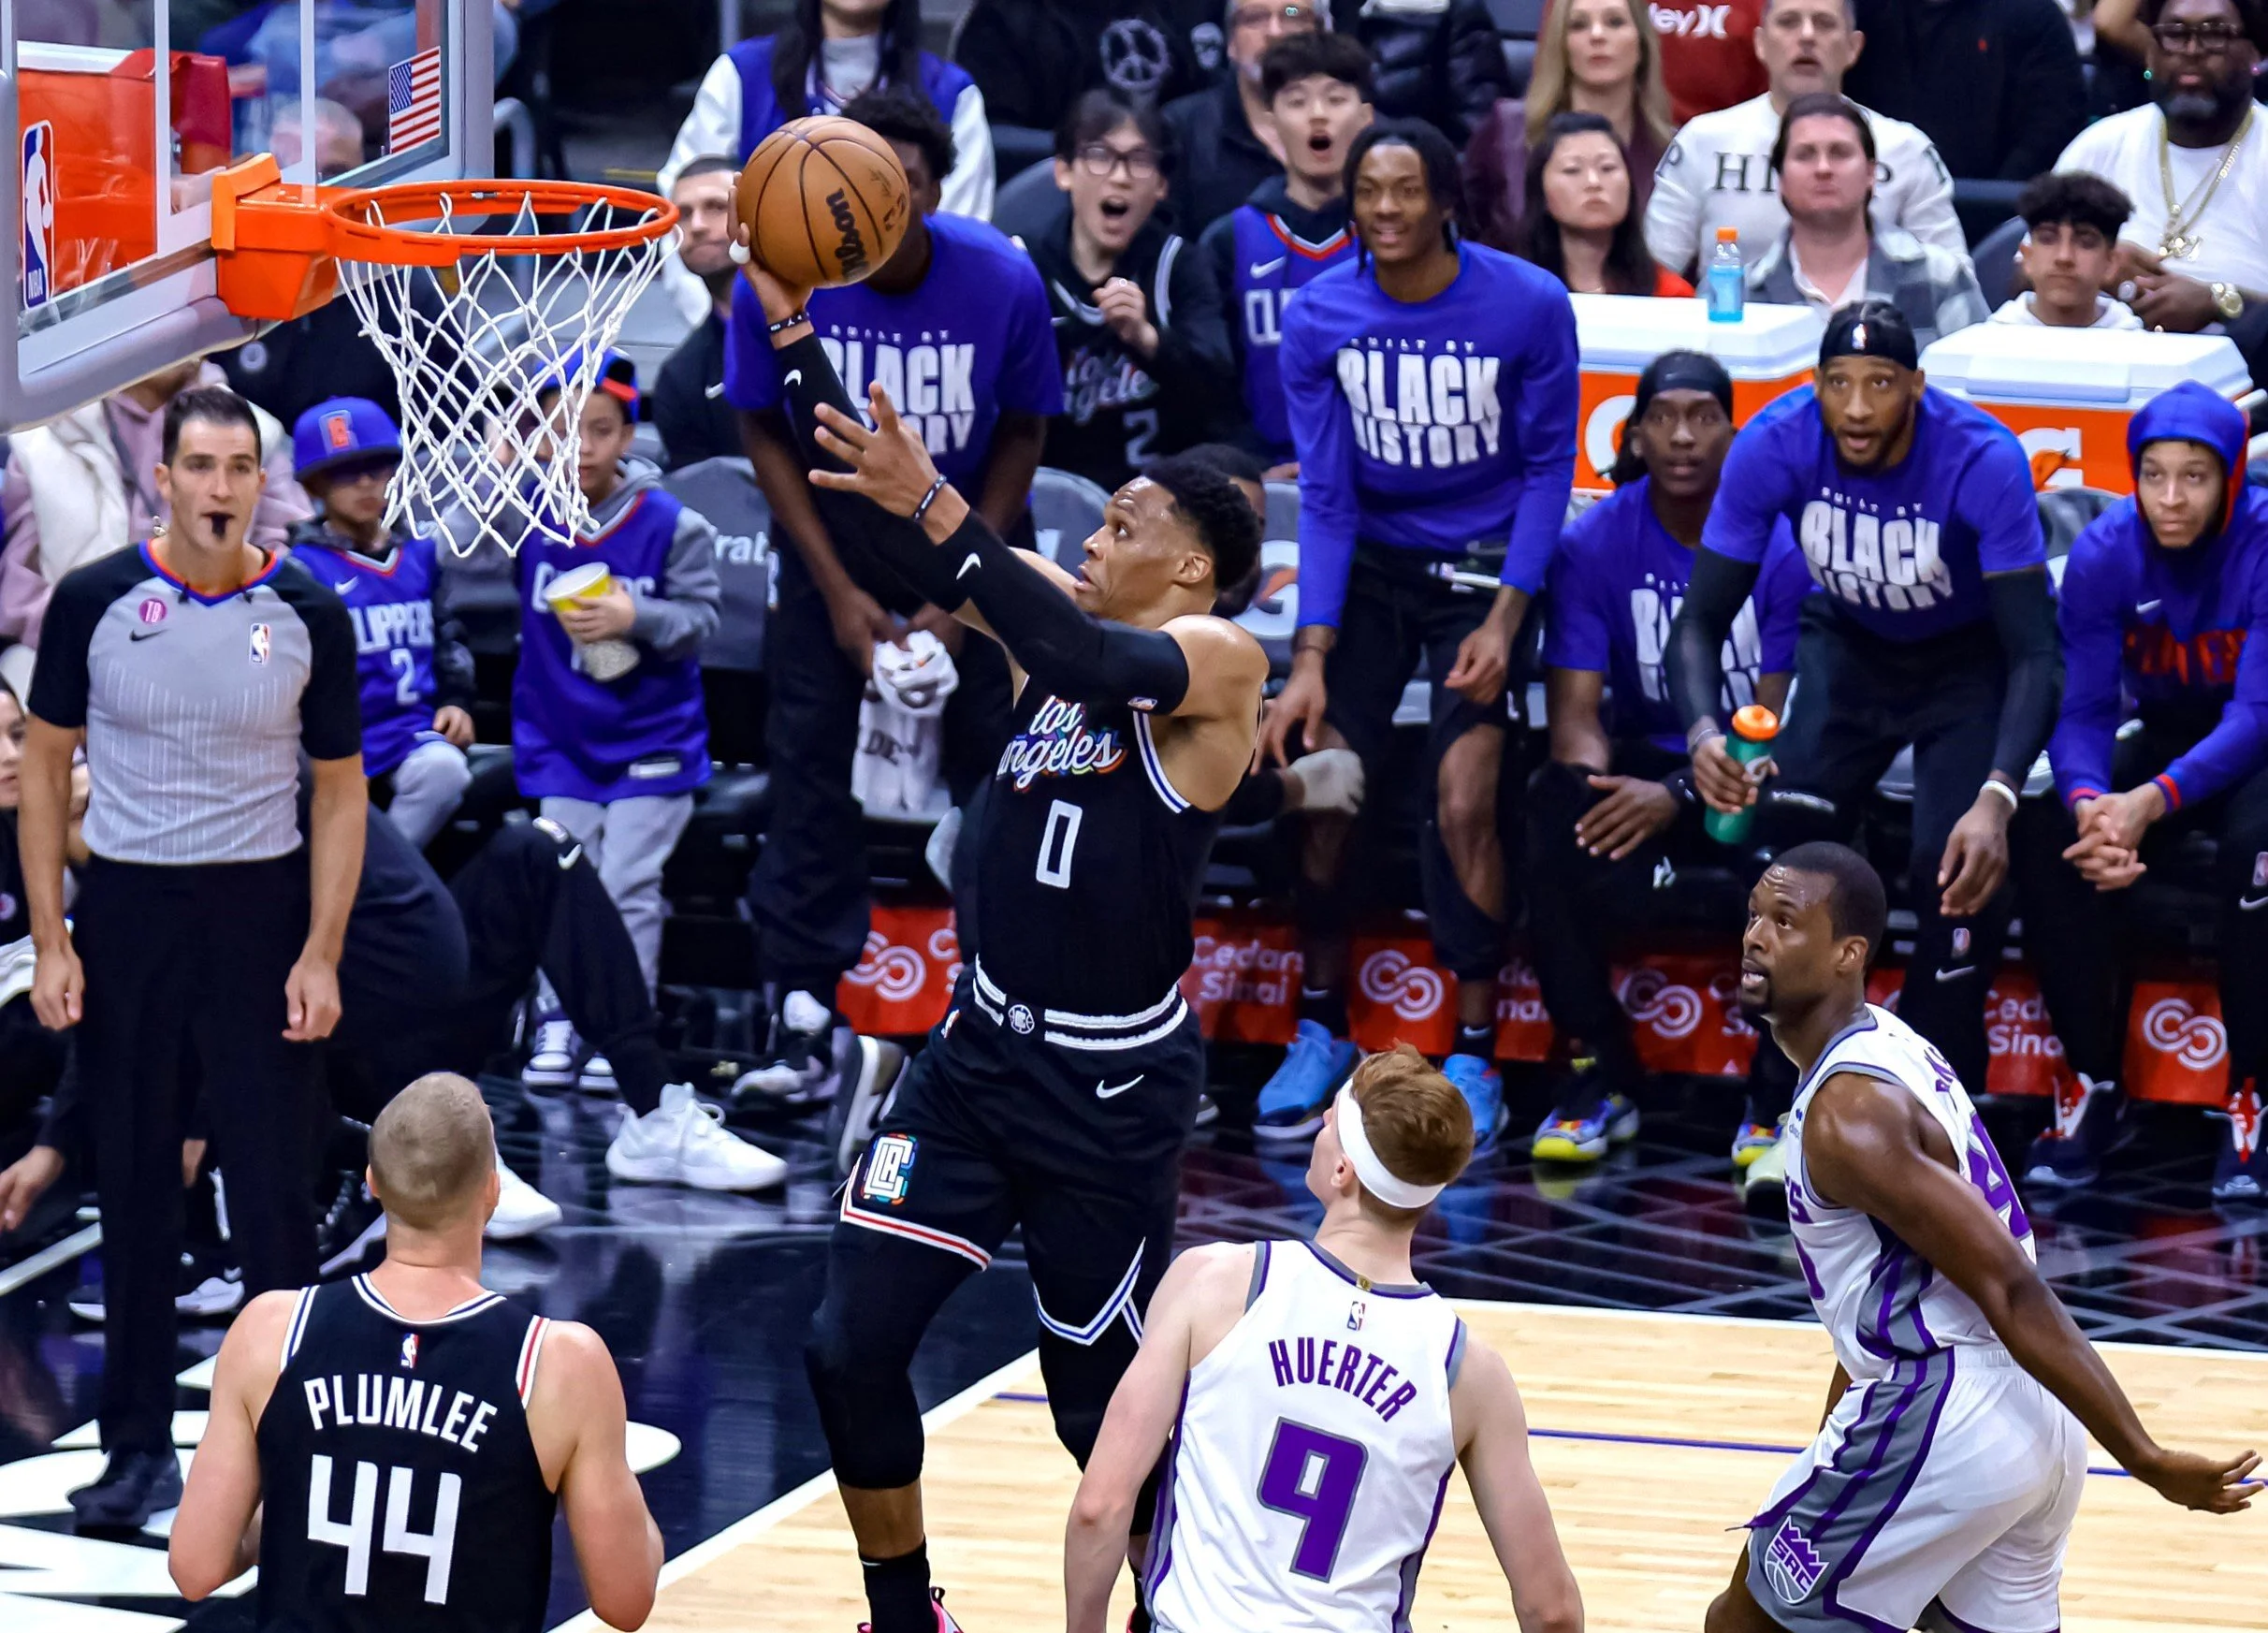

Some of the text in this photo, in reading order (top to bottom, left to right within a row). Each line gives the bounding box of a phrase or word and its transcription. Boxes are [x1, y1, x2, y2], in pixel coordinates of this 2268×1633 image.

[28, 268, 44, 299] NBA
[1336, 347, 1501, 427] BLACK
[1124, 408, 1161, 466] 2
[1352, 409, 1502, 469] HISTORY
[1800, 501, 1947, 586] BLACK
[390, 648, 419, 705] 2
[1036, 798, 1083, 889] 0
[303, 1373, 498, 1452] PLUMLEE
[1268, 1336, 1418, 1423] HUERTER
[308, 1453, 462, 1605] 44
[1256, 1415, 1370, 1583] 9
